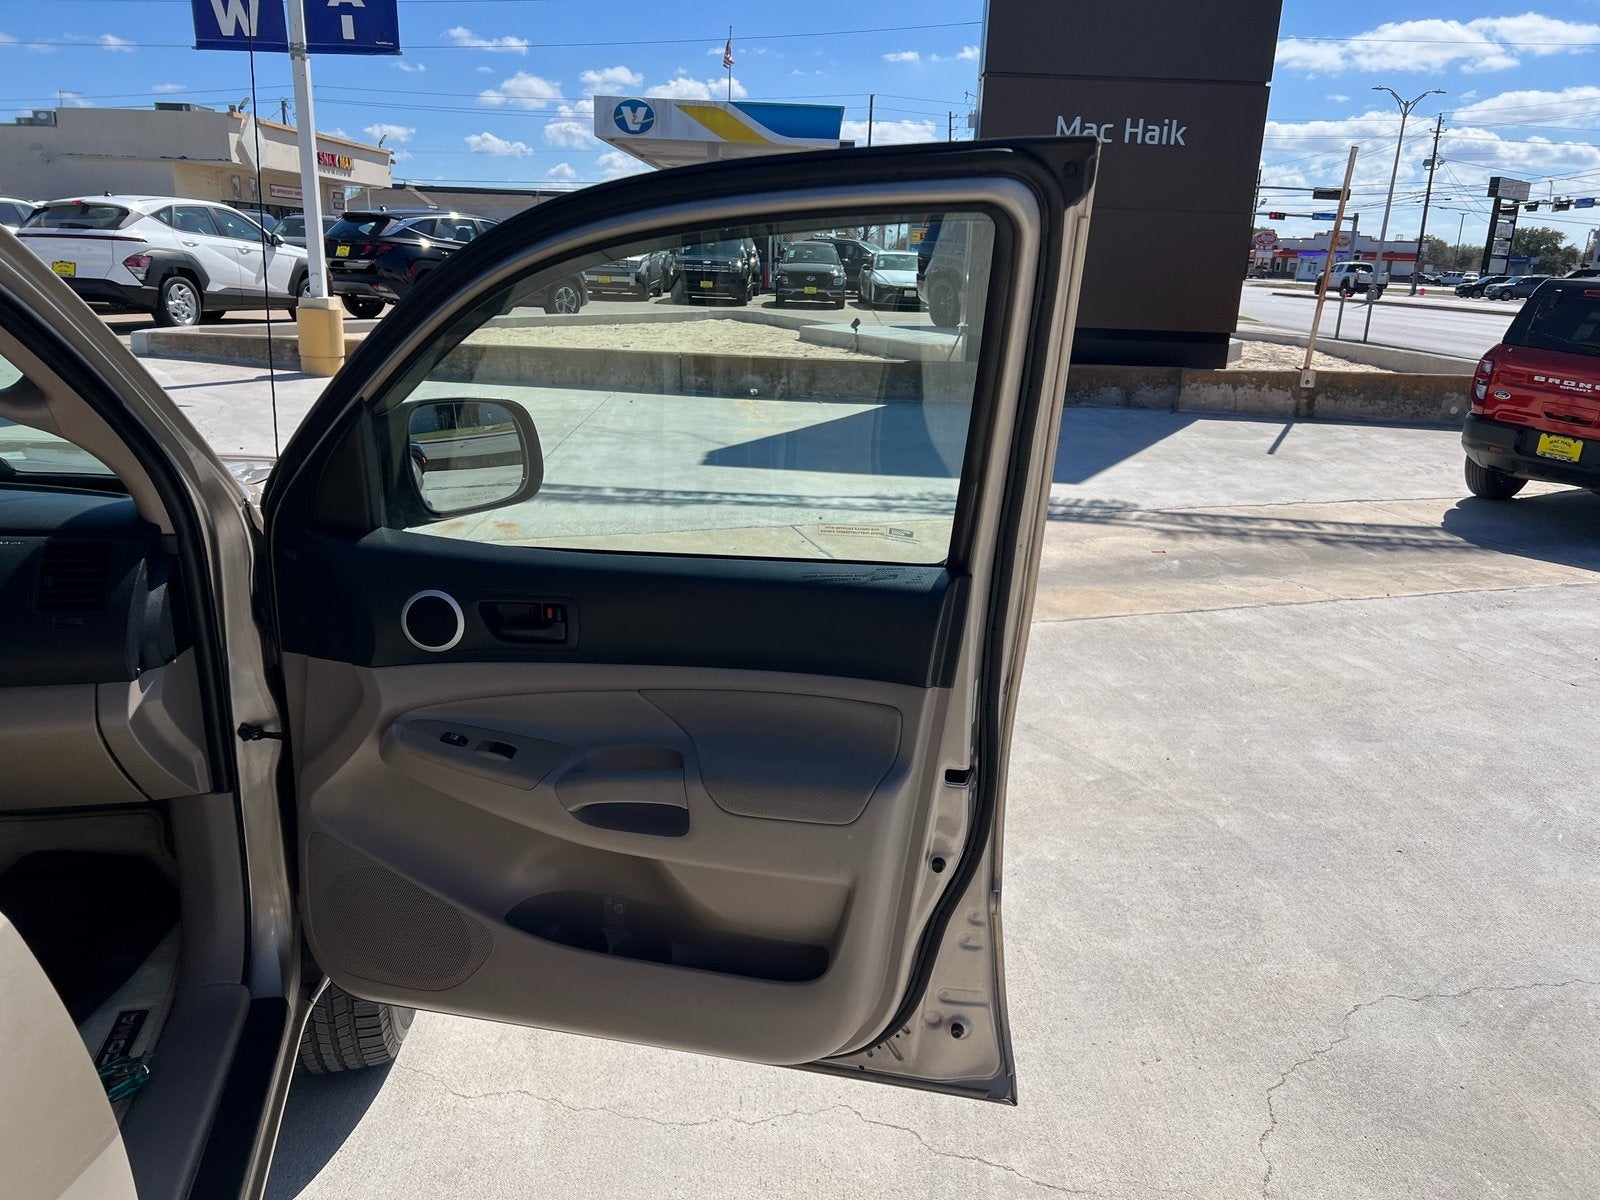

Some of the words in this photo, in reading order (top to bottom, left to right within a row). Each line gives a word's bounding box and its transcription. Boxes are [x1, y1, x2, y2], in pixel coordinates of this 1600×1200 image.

[1055, 115, 1115, 144] Mac
[1123, 117, 1188, 146] Haik
[1560, 385, 1593, 393] SPORT
